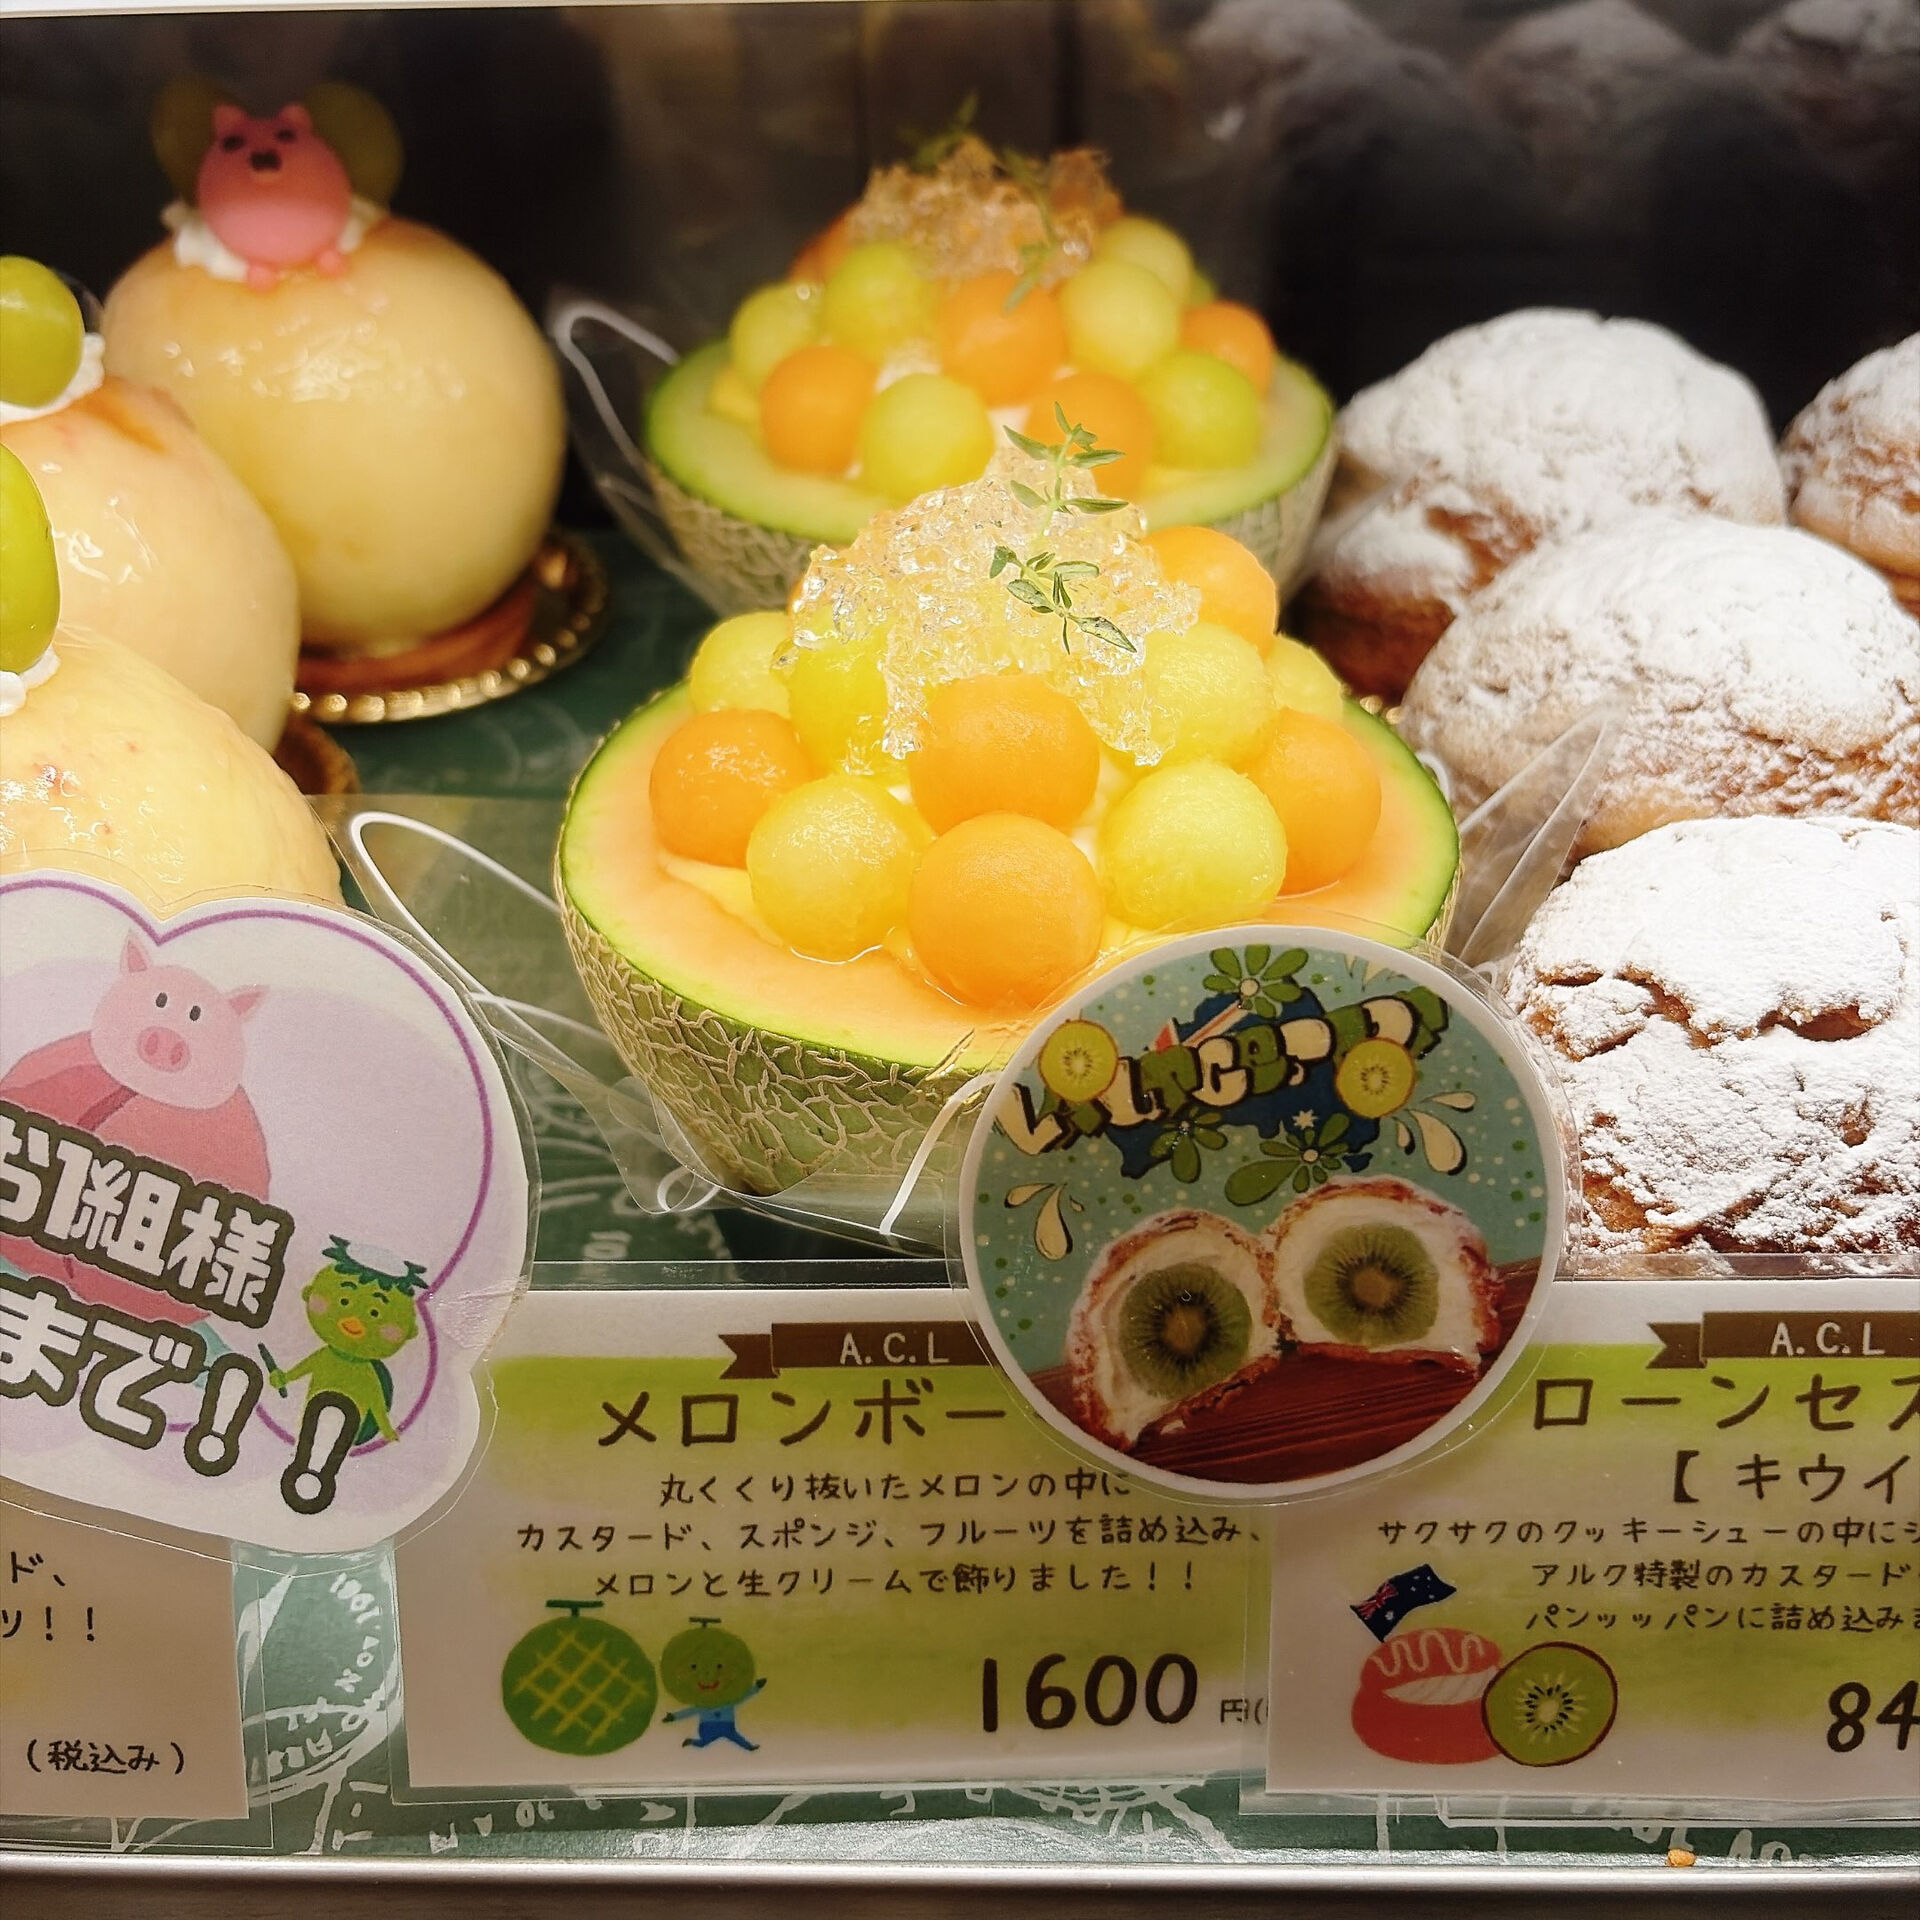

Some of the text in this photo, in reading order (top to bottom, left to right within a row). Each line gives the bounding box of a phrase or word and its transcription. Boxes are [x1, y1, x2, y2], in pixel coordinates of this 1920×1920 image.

[840, 1332, 949, 1366] A.C.L
[1770, 1321, 1885, 1356] A.C.L
[598, 1377, 1006, 1446] メロンボー
[660, 1467, 1131, 1507] 丸くくり抜いたメロンの中に
[517, 1513, 1260, 1552] カスタード、スポンジ、フルーツを詰め込み、
[595, 1561, 1193, 1595] メロンと生クリームで飾りました！！
[982, 1653, 1198, 1733] 1600
[1826, 1680, 1920, 1753] 84
[27, 1739, 185, 1775] (税込み)
